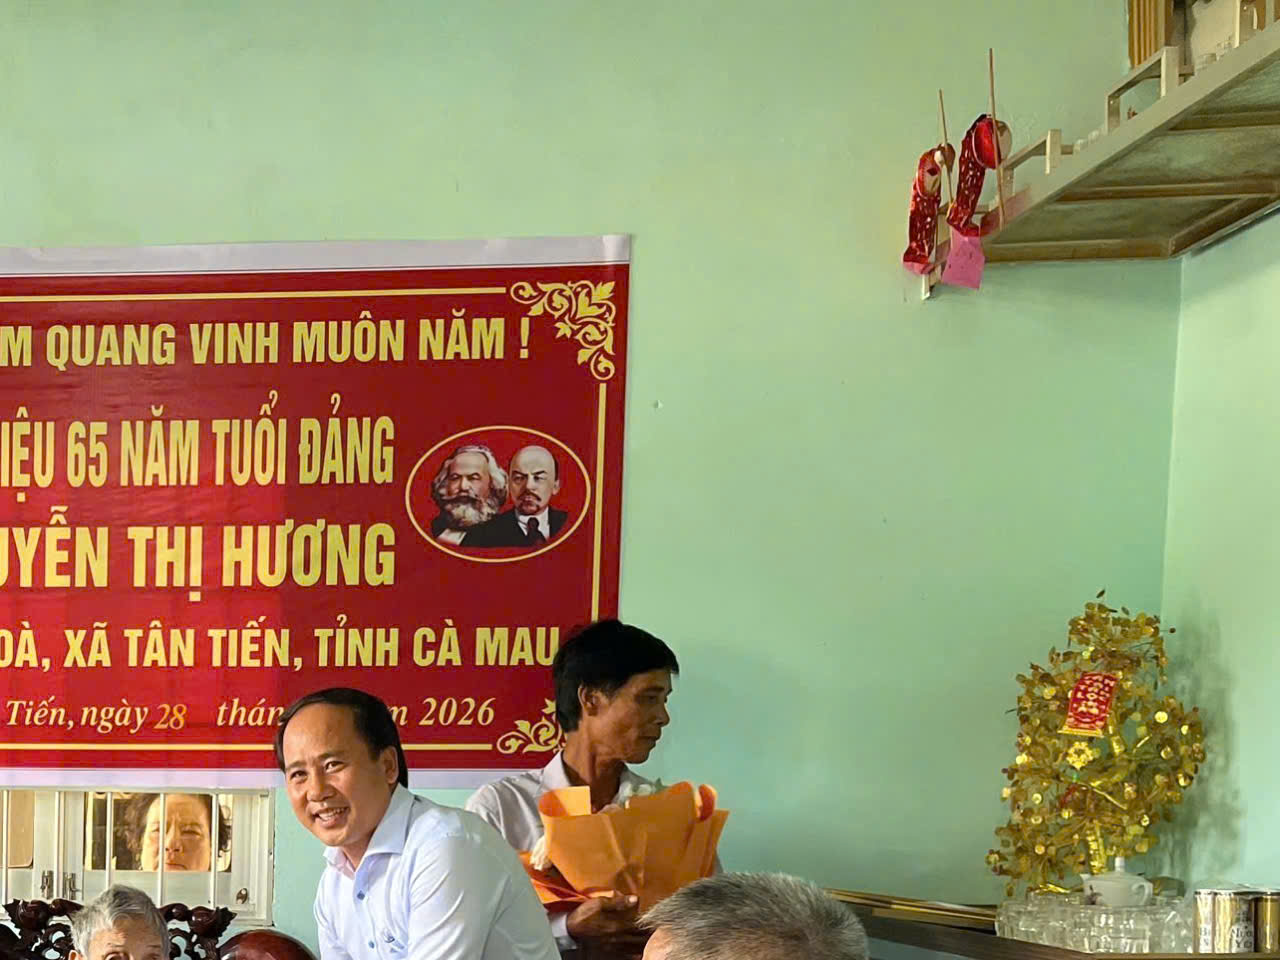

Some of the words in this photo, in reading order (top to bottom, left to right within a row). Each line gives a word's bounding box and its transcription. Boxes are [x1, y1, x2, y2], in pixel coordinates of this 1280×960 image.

[46, 323, 176, 372] QUANG
[189, 321, 279, 365] VINH
[292, 310, 405, 363] MUÔN
[418, 308, 505, 361] NĂM
[519, 316, 530, 359] !
[66, 420, 108, 488] 65
[119, 404, 200, 487] NĂM
[211, 389, 287, 486] TUỔI
[298, 392, 395, 484] ĐẢNG
[127, 525, 203, 602] THỊ
[222, 518, 395, 587] HƯƠNG
[63, 621, 112, 668] XÃ
[123, 619, 195, 667] TÂN
[207, 615, 303, 672] TIẾN,
[314, 613, 399, 667] TỈNH
[413, 618, 462, 667] CÀ
[475, 626, 560, 666] MAU
[6, 695, 74, 730] Tiến,
[80, 698, 149, 734] ngày
[154, 703, 187, 730] 28
[216, 697, 284, 726] thán
[418, 697, 495, 726] 2026
